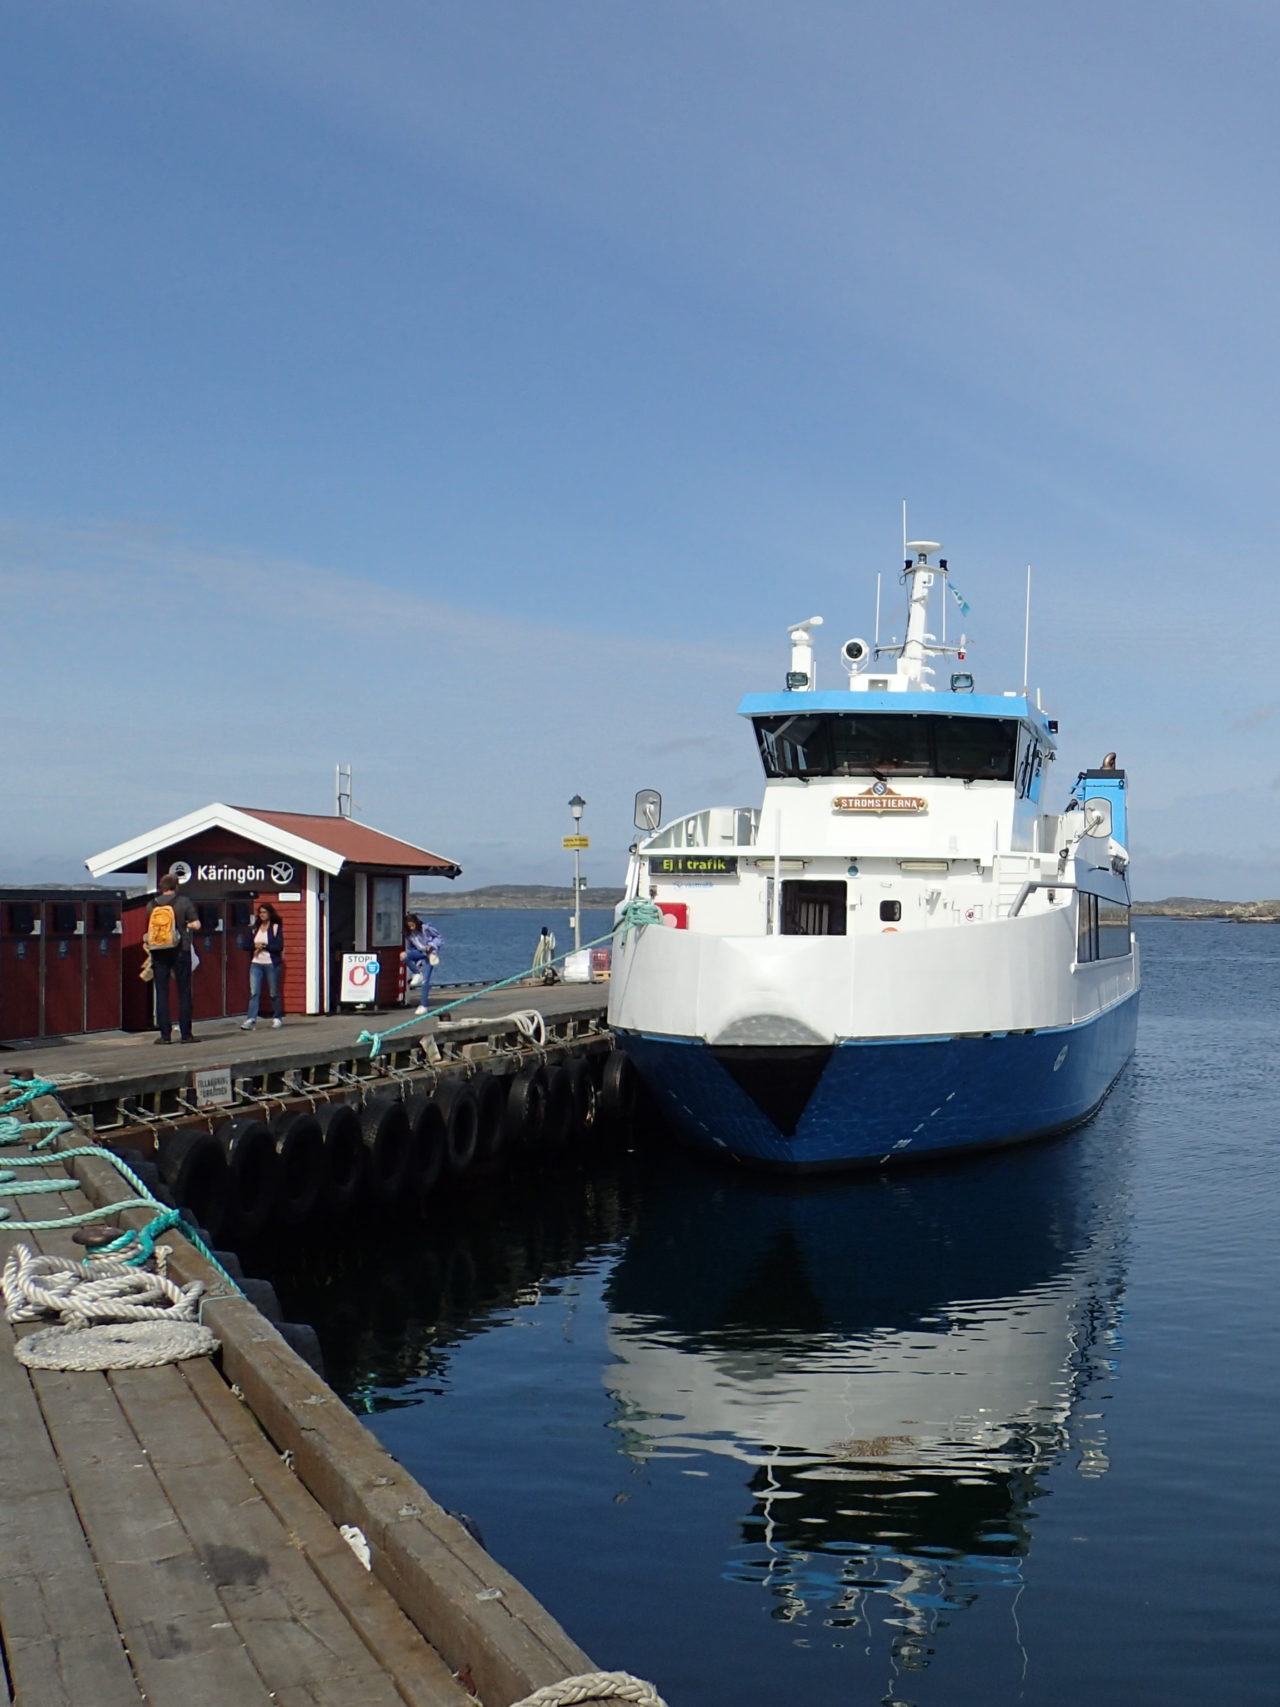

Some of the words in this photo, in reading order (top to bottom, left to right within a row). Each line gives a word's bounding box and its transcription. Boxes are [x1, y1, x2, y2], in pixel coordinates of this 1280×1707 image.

[663, 859, 674, 871] Ej
[687, 859, 726, 869] trafik
[198, 865, 265, 883] Käringön
